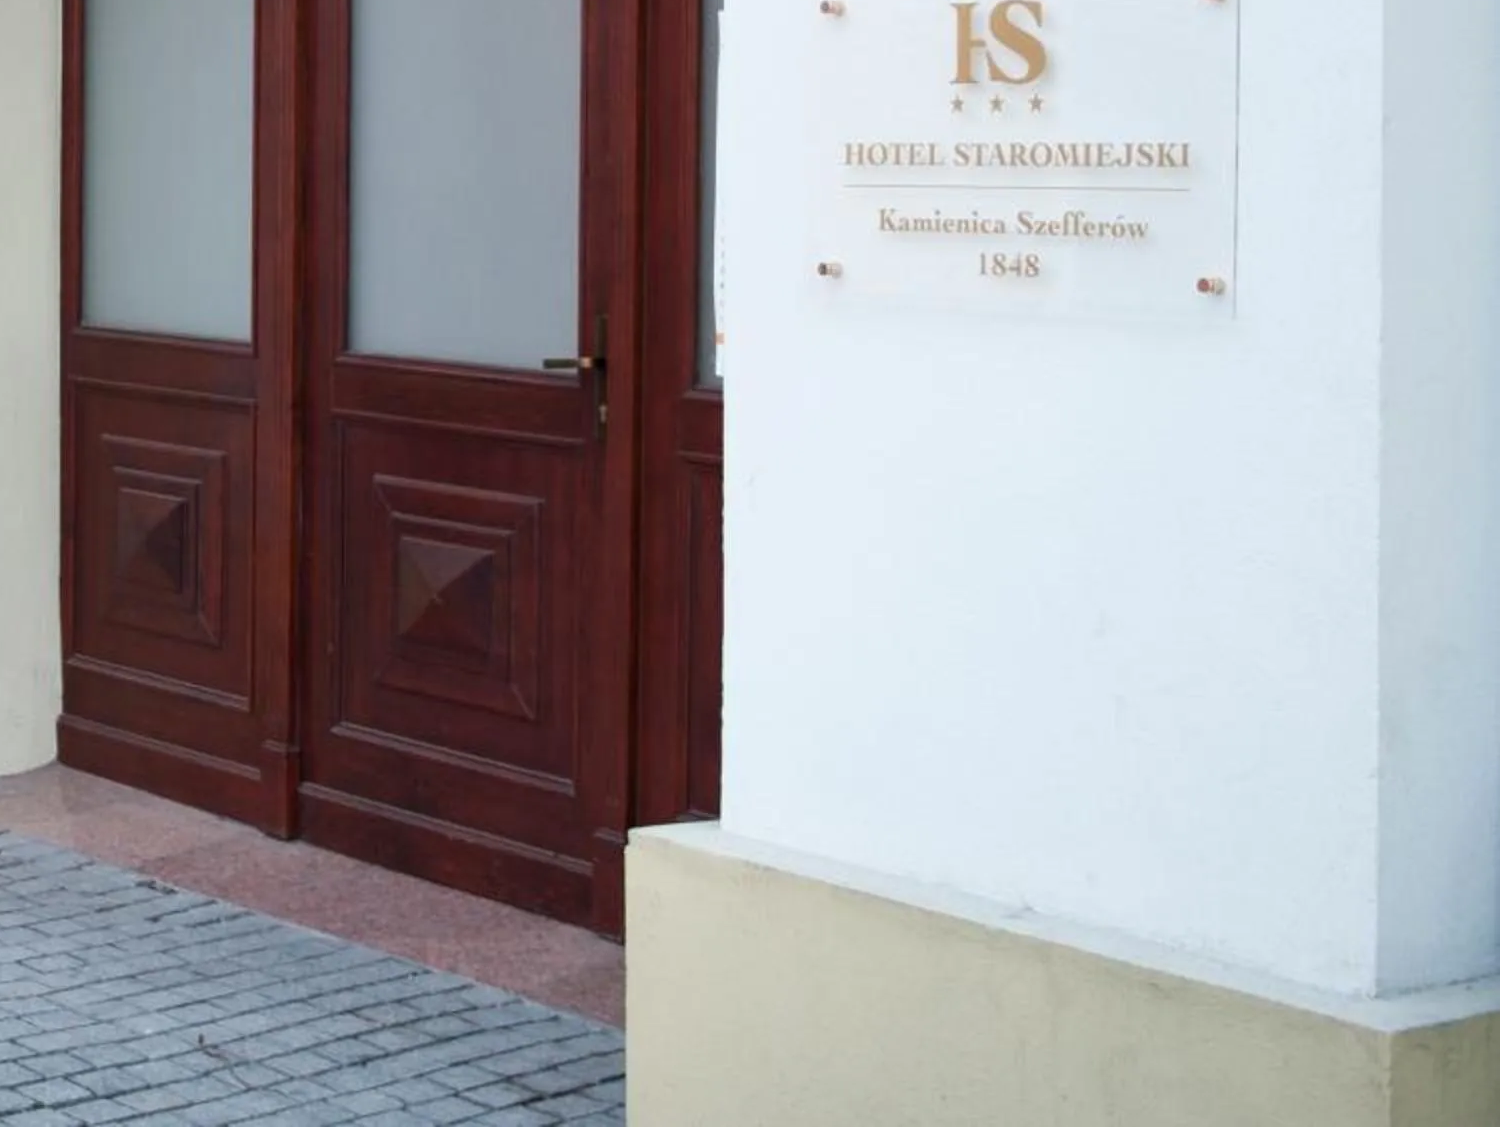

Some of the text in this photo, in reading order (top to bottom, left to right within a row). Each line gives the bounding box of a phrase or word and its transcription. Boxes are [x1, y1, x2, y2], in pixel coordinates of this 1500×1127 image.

[844, 142, 1191, 169] HOTEL STAROMIEJSKI
[878, 208, 1149, 239] Kamienica Szefferów
[978, 252, 1041, 278] 1848
